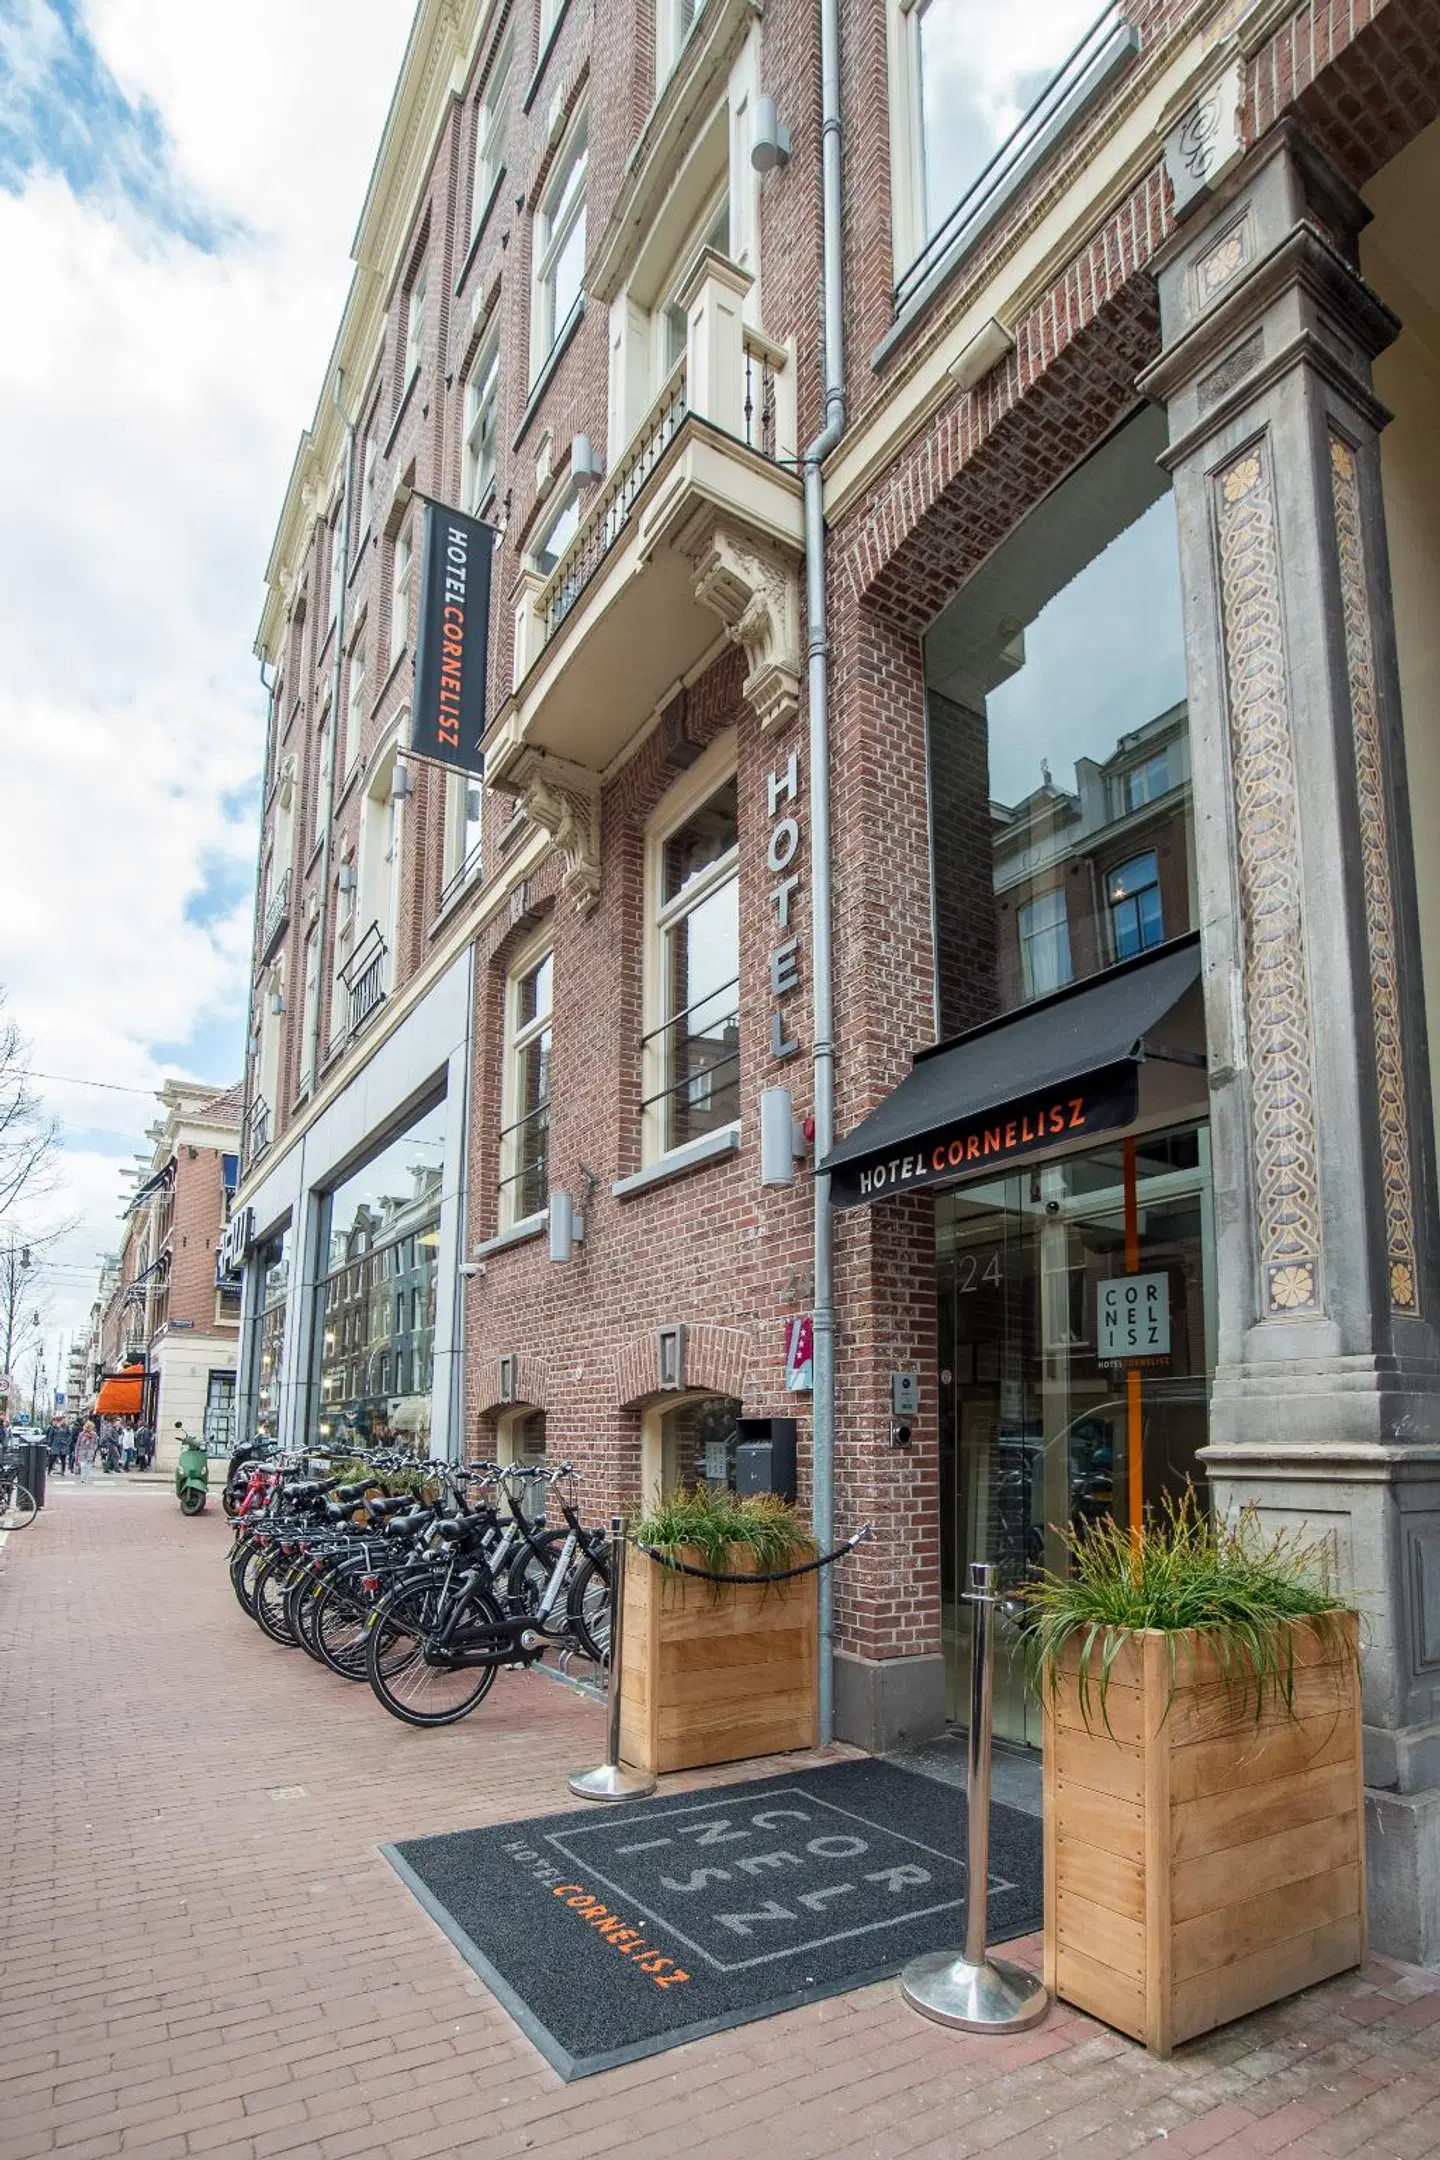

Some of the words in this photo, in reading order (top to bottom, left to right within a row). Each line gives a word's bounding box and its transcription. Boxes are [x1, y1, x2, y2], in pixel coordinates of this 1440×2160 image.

[767, 753, 800, 1059] HOTEL
[959, 1250, 1003, 1294] 24
[1105, 1284, 1158, 1306] COR
[1105, 1306, 1157, 1327] NEL
[1109, 1326, 1159, 1347] ISZ
